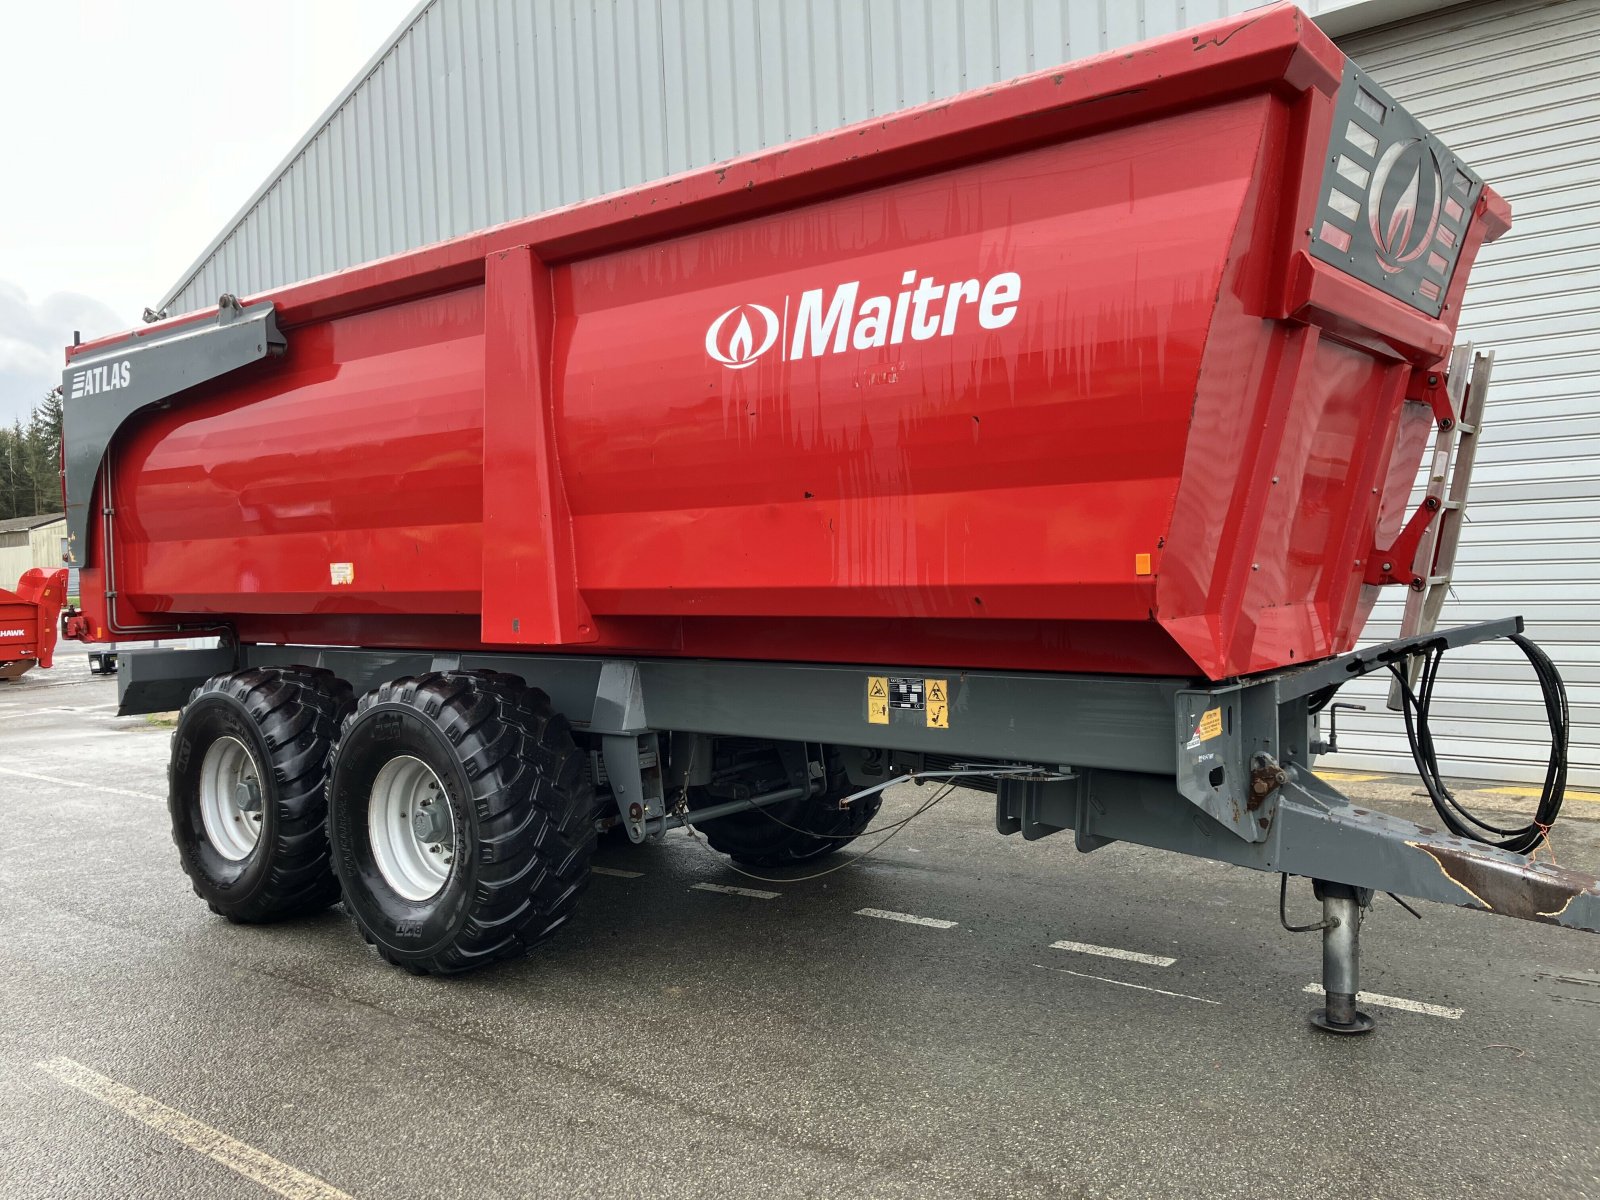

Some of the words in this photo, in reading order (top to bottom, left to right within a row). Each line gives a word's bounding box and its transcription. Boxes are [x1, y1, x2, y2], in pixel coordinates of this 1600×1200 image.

[789, 269, 1022, 361] Maitre
[83, 360, 131, 397] ATLAS
[0, 629, 25, 637] HAWK
